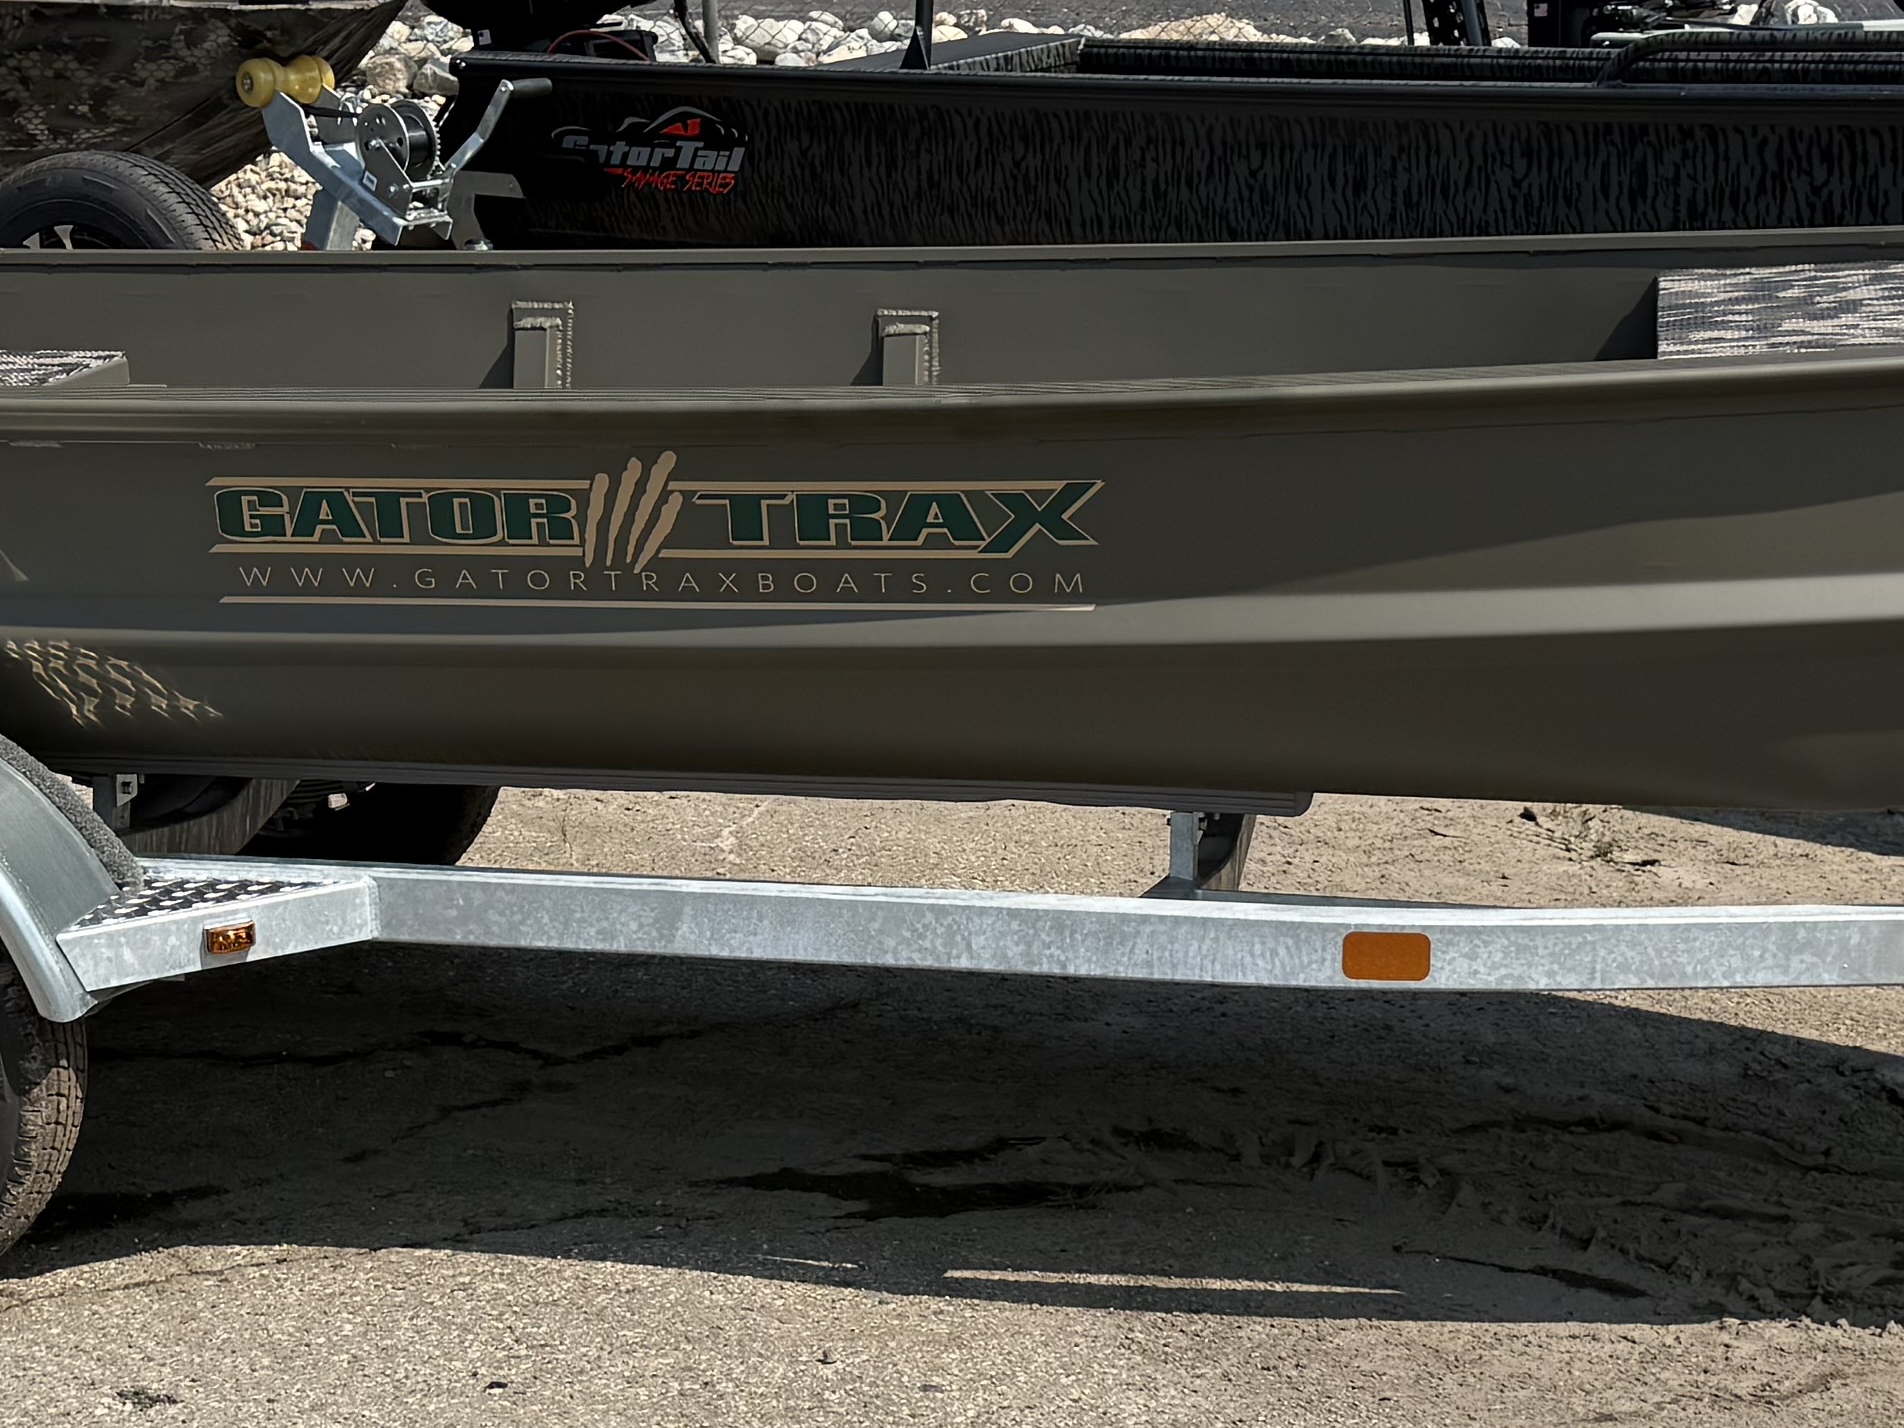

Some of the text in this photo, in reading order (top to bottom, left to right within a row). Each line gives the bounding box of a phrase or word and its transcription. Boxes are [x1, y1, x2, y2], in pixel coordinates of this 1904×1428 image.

[683, 172, 736, 194] SERIES
[212, 480, 1104, 557] GATOR TRAX
[239, 566, 1086, 595] WWW.GATORTRAXBOATS.COM
